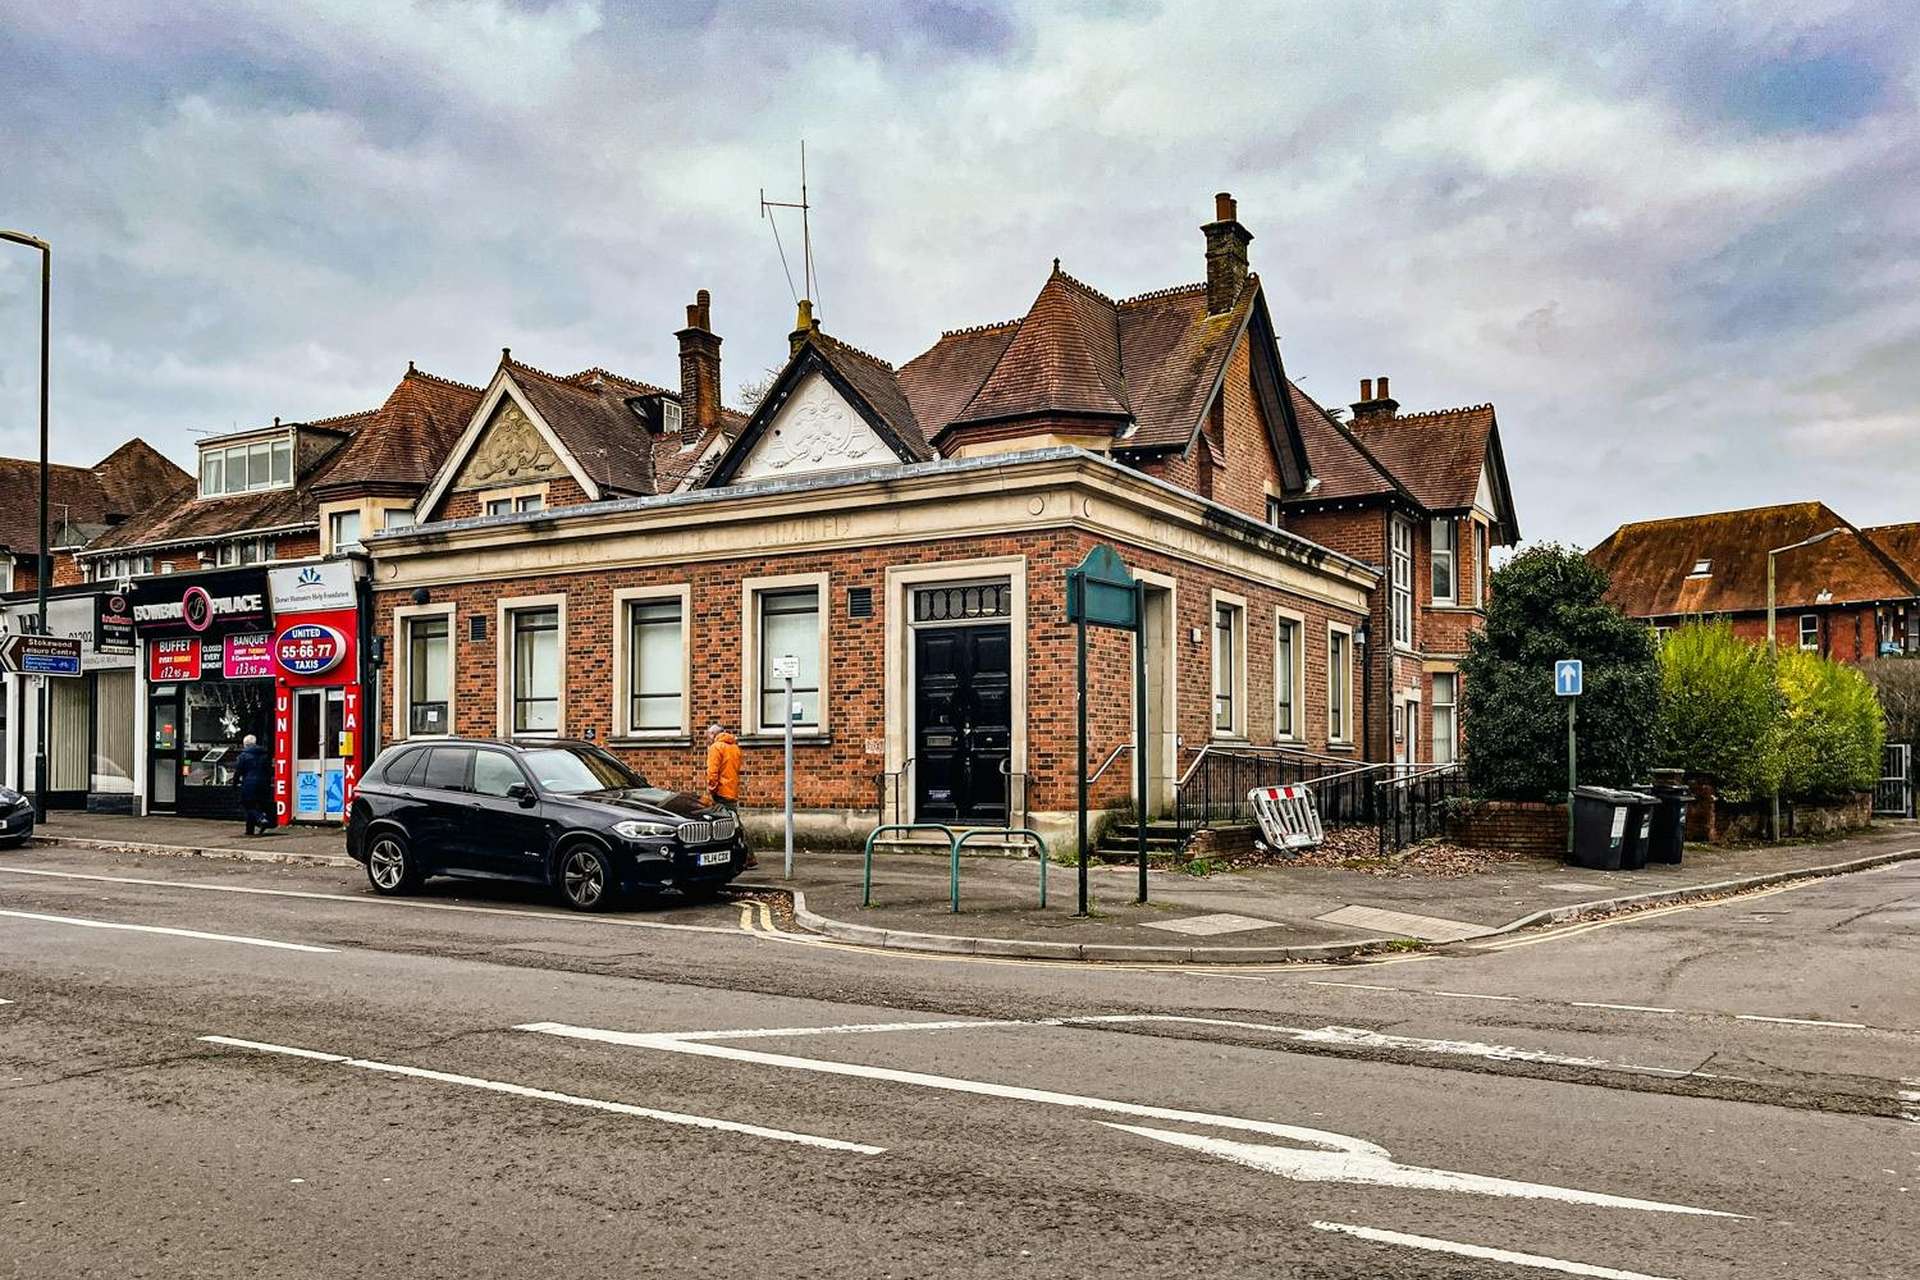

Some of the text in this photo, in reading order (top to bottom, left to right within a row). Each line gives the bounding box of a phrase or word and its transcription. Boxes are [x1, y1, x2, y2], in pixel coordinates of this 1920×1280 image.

[212, 594, 263, 614] PALACE
[102, 613, 133, 625] Indian
[292, 629, 321, 638] UNITED
[28, 638, 73, 648] Stokewood
[160, 639, 192, 653] BUFFET
[233, 635, 268, 647] BANQUET
[22, 646, 49, 655] Leisure
[51, 648, 77, 657] Centre
[202, 645, 222, 653] CLOSED
[203, 653, 220, 661] EVERY
[202, 661, 223, 670] MONDAY
[295, 660, 319, 670] TAXIS
[276, 697, 288, 815] UNITED
